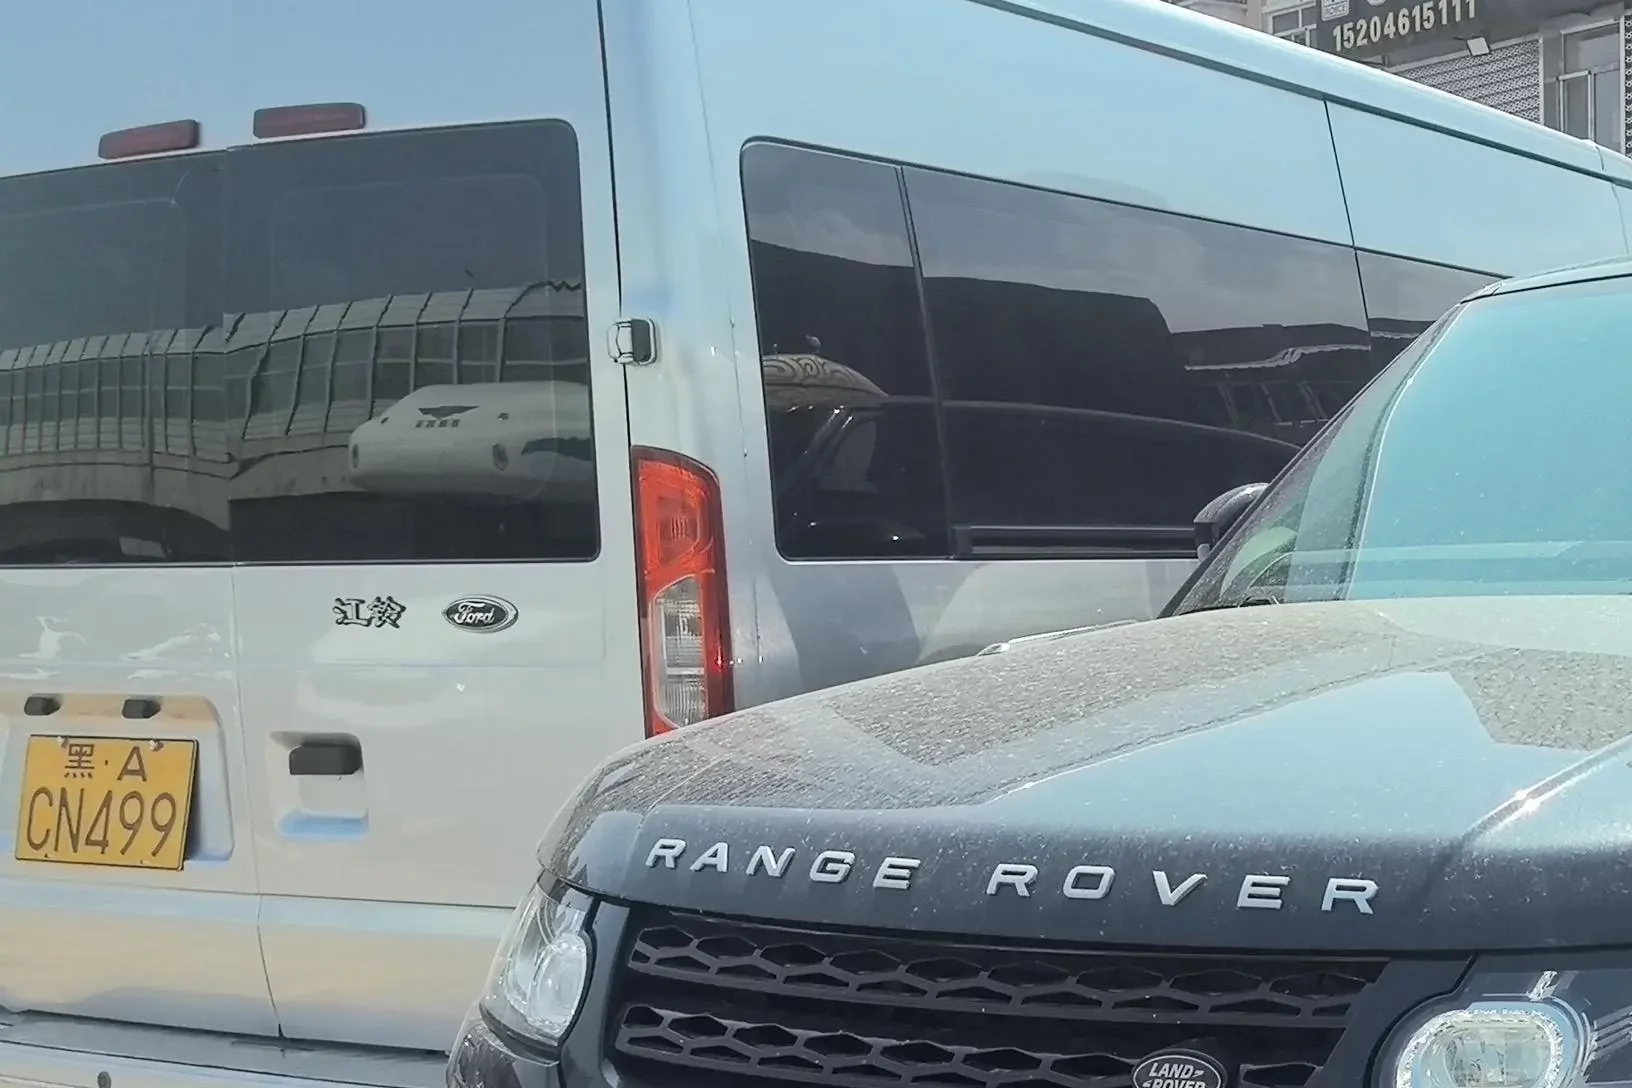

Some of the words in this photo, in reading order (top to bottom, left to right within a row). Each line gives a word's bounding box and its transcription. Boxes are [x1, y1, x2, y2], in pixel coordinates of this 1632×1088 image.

[1333, 0, 1476, 51] 15204615111
[333, 596, 406, 628] 江铃
[454, 601, 495, 624] Ford
[27, 787, 177, 857] CN499
[646, 838, 921, 890] RANGE
[986, 863, 1379, 914] ROVER
[1148, 1062, 1194, 1079] LAND
